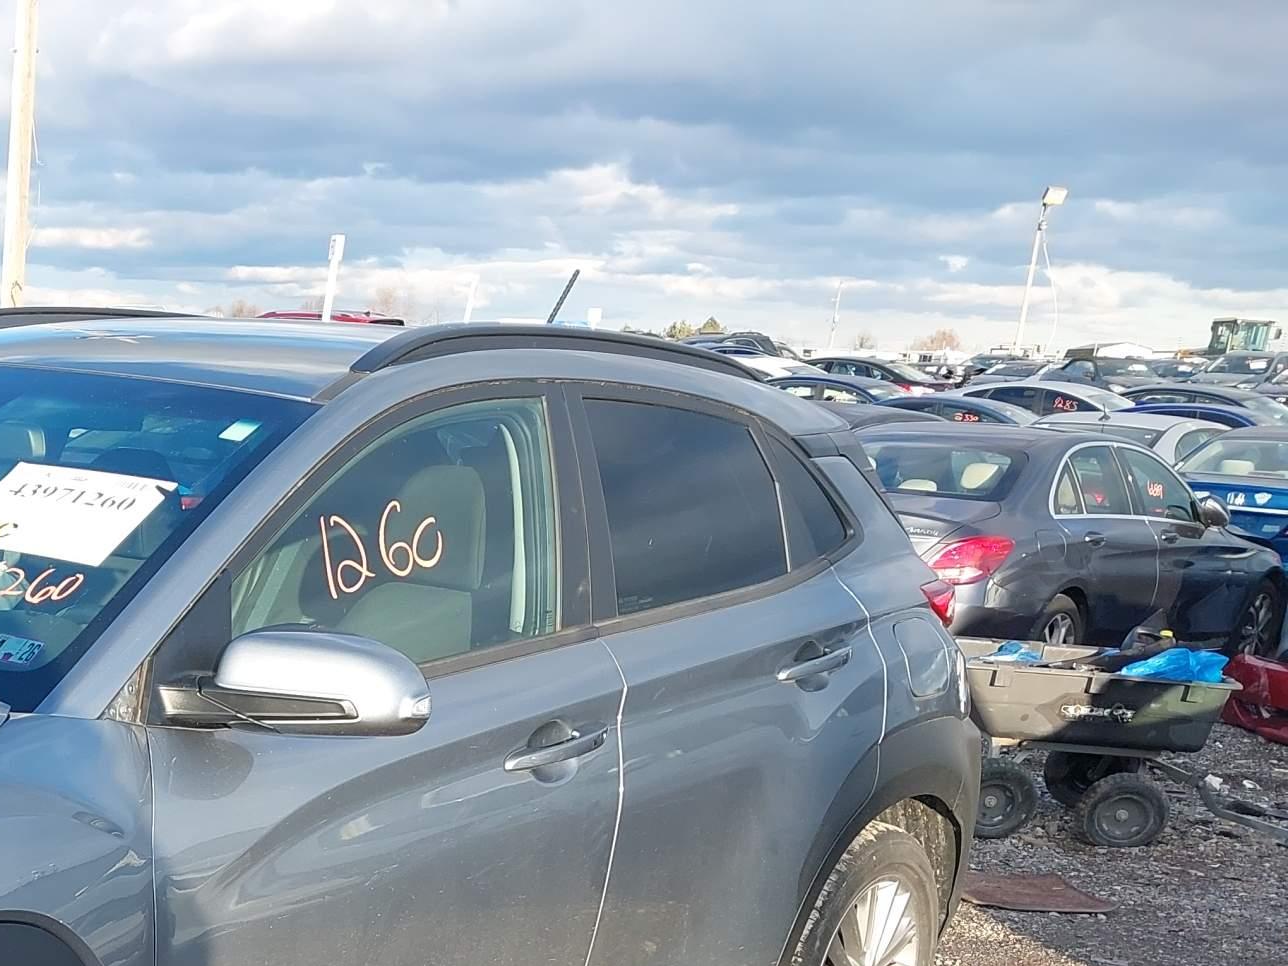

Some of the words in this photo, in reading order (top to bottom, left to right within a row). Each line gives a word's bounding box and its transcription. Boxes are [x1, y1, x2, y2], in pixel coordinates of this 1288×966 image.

[9, 483, 137, 512] 43971260
[320, 500, 443, 600] 1260
[17, 643, 43, 663] 26
